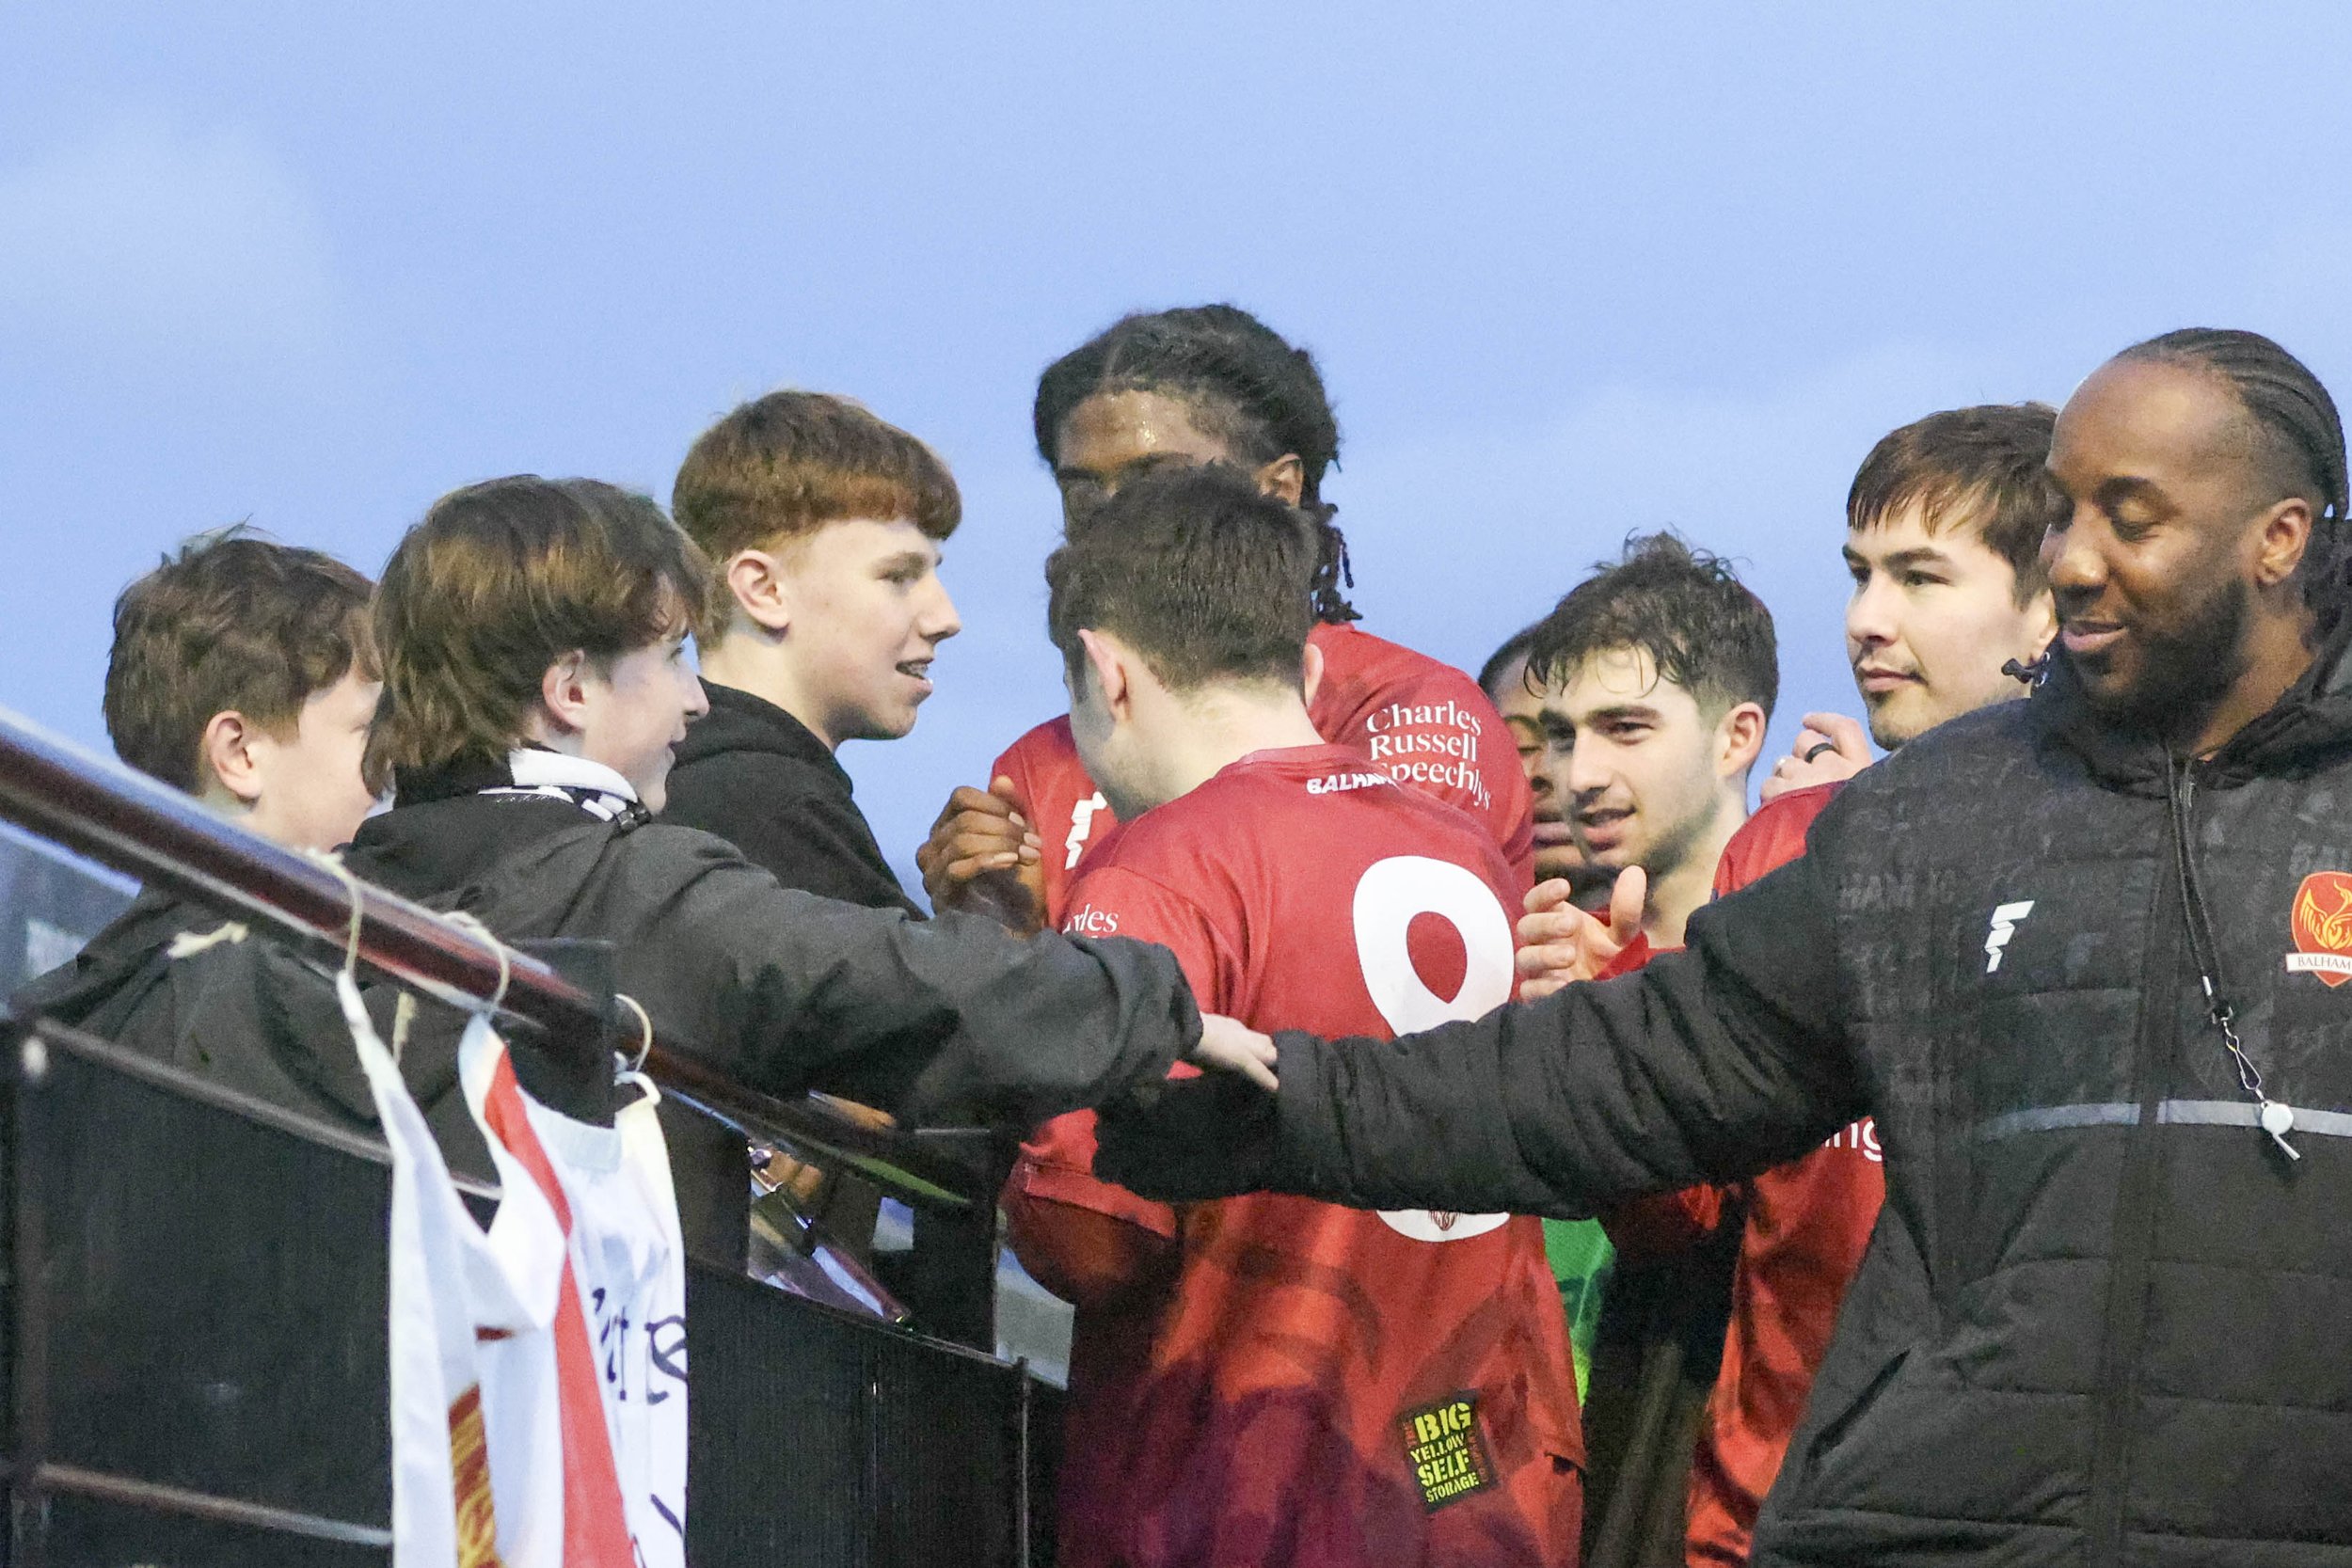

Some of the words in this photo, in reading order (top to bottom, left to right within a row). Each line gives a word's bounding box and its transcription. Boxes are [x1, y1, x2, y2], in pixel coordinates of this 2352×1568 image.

[1366, 700, 1482, 736] Charles
[1370, 732, 1478, 762] Russell
[1380, 761, 1491, 811] peechlys
[2297, 956, 2351, 970] BALHAM
[1414, 1402, 1471, 1444] BIG
[1410, 1433, 1465, 1464] YELLOW
[1417, 1448, 1470, 1487] SELF
[1425, 1472, 1480, 1503] STORAGE
